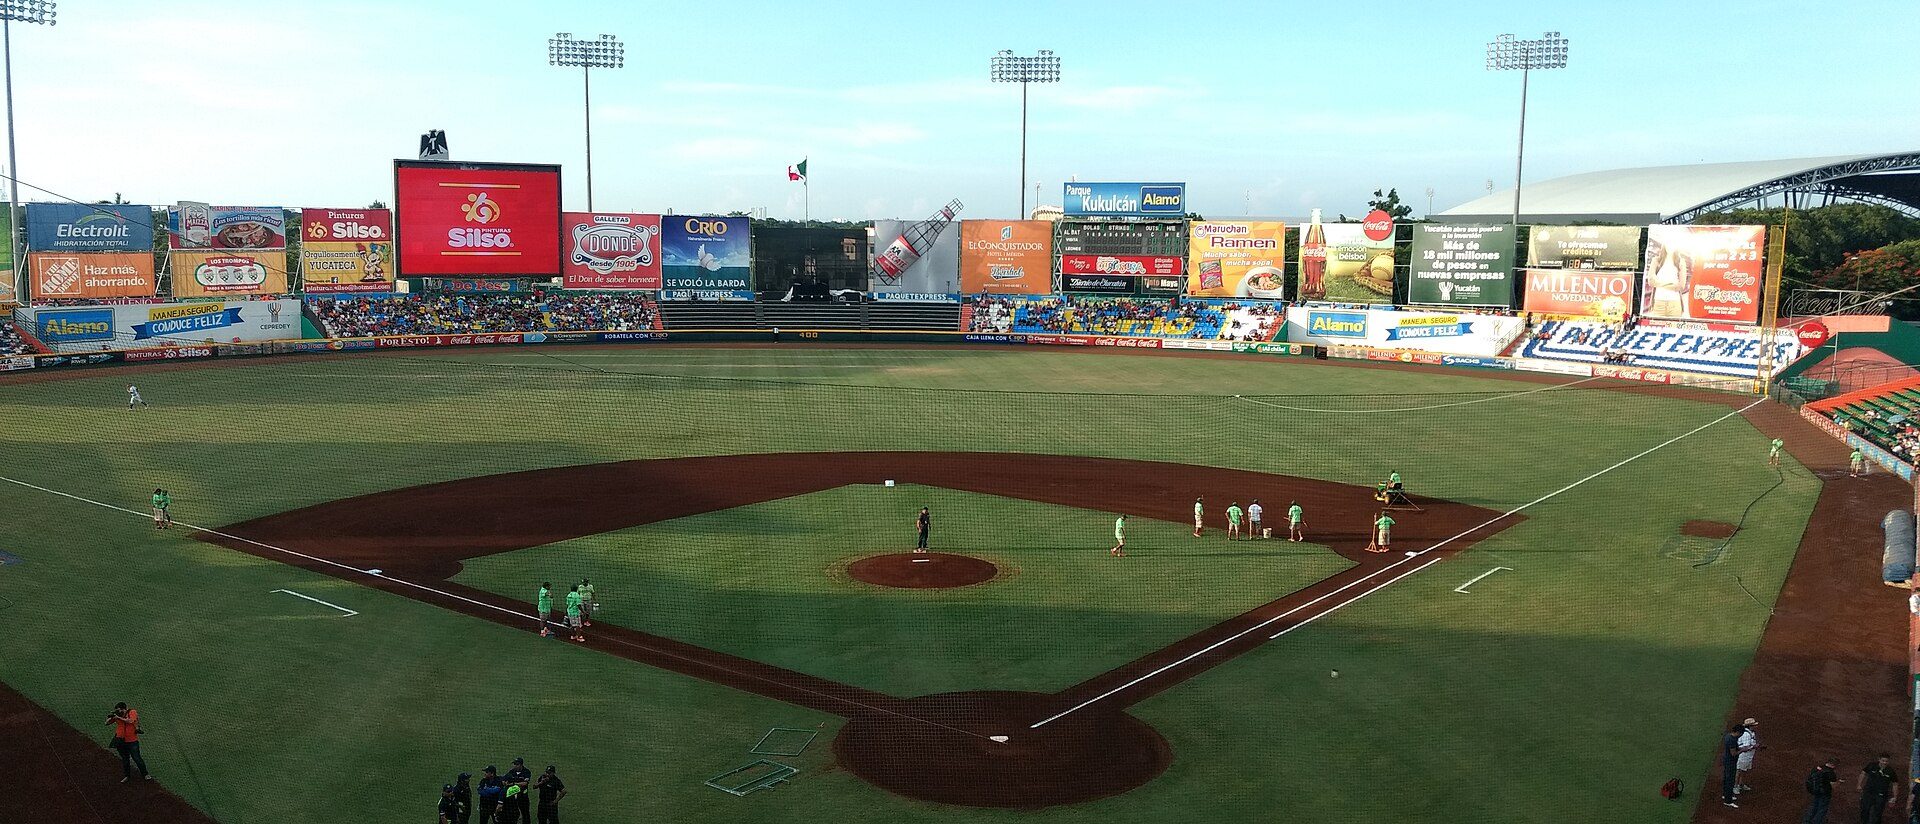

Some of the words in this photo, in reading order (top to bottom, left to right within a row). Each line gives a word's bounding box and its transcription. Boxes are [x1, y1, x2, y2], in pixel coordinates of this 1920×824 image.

[1066, 185, 1091, 197] Parque
[1082, 194, 1137, 212] Kukulcán
[1143, 193, 1180, 205] Alamo
[328, 211, 365, 219] Pinturas
[57, 224, 129, 238] Electrolit
[332, 222, 382, 239] Silso
[1204, 224, 1247, 233] Maruchan
[1423, 225, 1453, 233] Yucatán
[1478, 226, 1504, 234] puertas
[54, 239, 104, 247] ¡HIDRATACIÓN
[448, 227, 511, 248] Silso
[589, 232, 637, 253] DONDÉ
[1211, 236, 1276, 249] Ramen
[969, 241, 978, 250] EL
[978, 240, 1044, 252] CONQUISTADOR
[1443, 240, 1465, 250] Más
[1465, 240, 1480, 250] de
[304, 250, 360, 259] Orgullosamente
[1201, 251, 1228, 259] ¡Mucho
[1338, 252, 1367, 261] béisbol
[1436, 250, 1454, 260] mil
[1455, 250, 1501, 260] millones
[1729, 250, 1736, 261] 2
[1748, 250, 1757, 261] 3
[309, 261, 357, 270] YUCATECA
[616, 260, 636, 268] 1905
[1252, 259, 1273, 267] sopa!
[1432, 259, 1445, 270] de
[1446, 261, 1478, 271] pesos
[45, 261, 62, 277] THE
[84, 264, 106, 276] Haz
[110, 264, 139, 276] más,
[42, 257, 80, 294] HOME
[569, 275, 576, 283] El
[605, 275, 626, 283] saber
[627, 275, 656, 283] hornear
[1417, 271, 1452, 279] nuevas
[1453, 271, 1505, 281] empresas
[57, 270, 80, 294] DEPOT
[85, 276, 148, 288] ahorrando.
[666, 279, 677, 287] SE
[678, 277, 703, 287] VOLÓ
[705, 279, 715, 287] LA
[717, 279, 746, 287] BARDA
[1530, 275, 1628, 295] MILENIO
[1454, 284, 1481, 292] Yucatán
[1552, 293, 1602, 302] NOVEDADES
[152, 310, 186, 320] MANEJA
[186, 304, 219, 315] SEGURO
[152, 320, 192, 334] CONDUCE
[194, 314, 223, 328] FELIZ
[1313, 316, 1363, 333] Alamo
[1430, 316, 1458, 324] SEGURO
[45, 318, 109, 336] Alamo
[1399, 328, 1431, 338] CONDUCE
[1433, 326, 1458, 336] FELIZ
[379, 337, 399, 346] POR
[127, 351, 162, 359] PINTURAS
[178, 348, 211, 357] Silso
